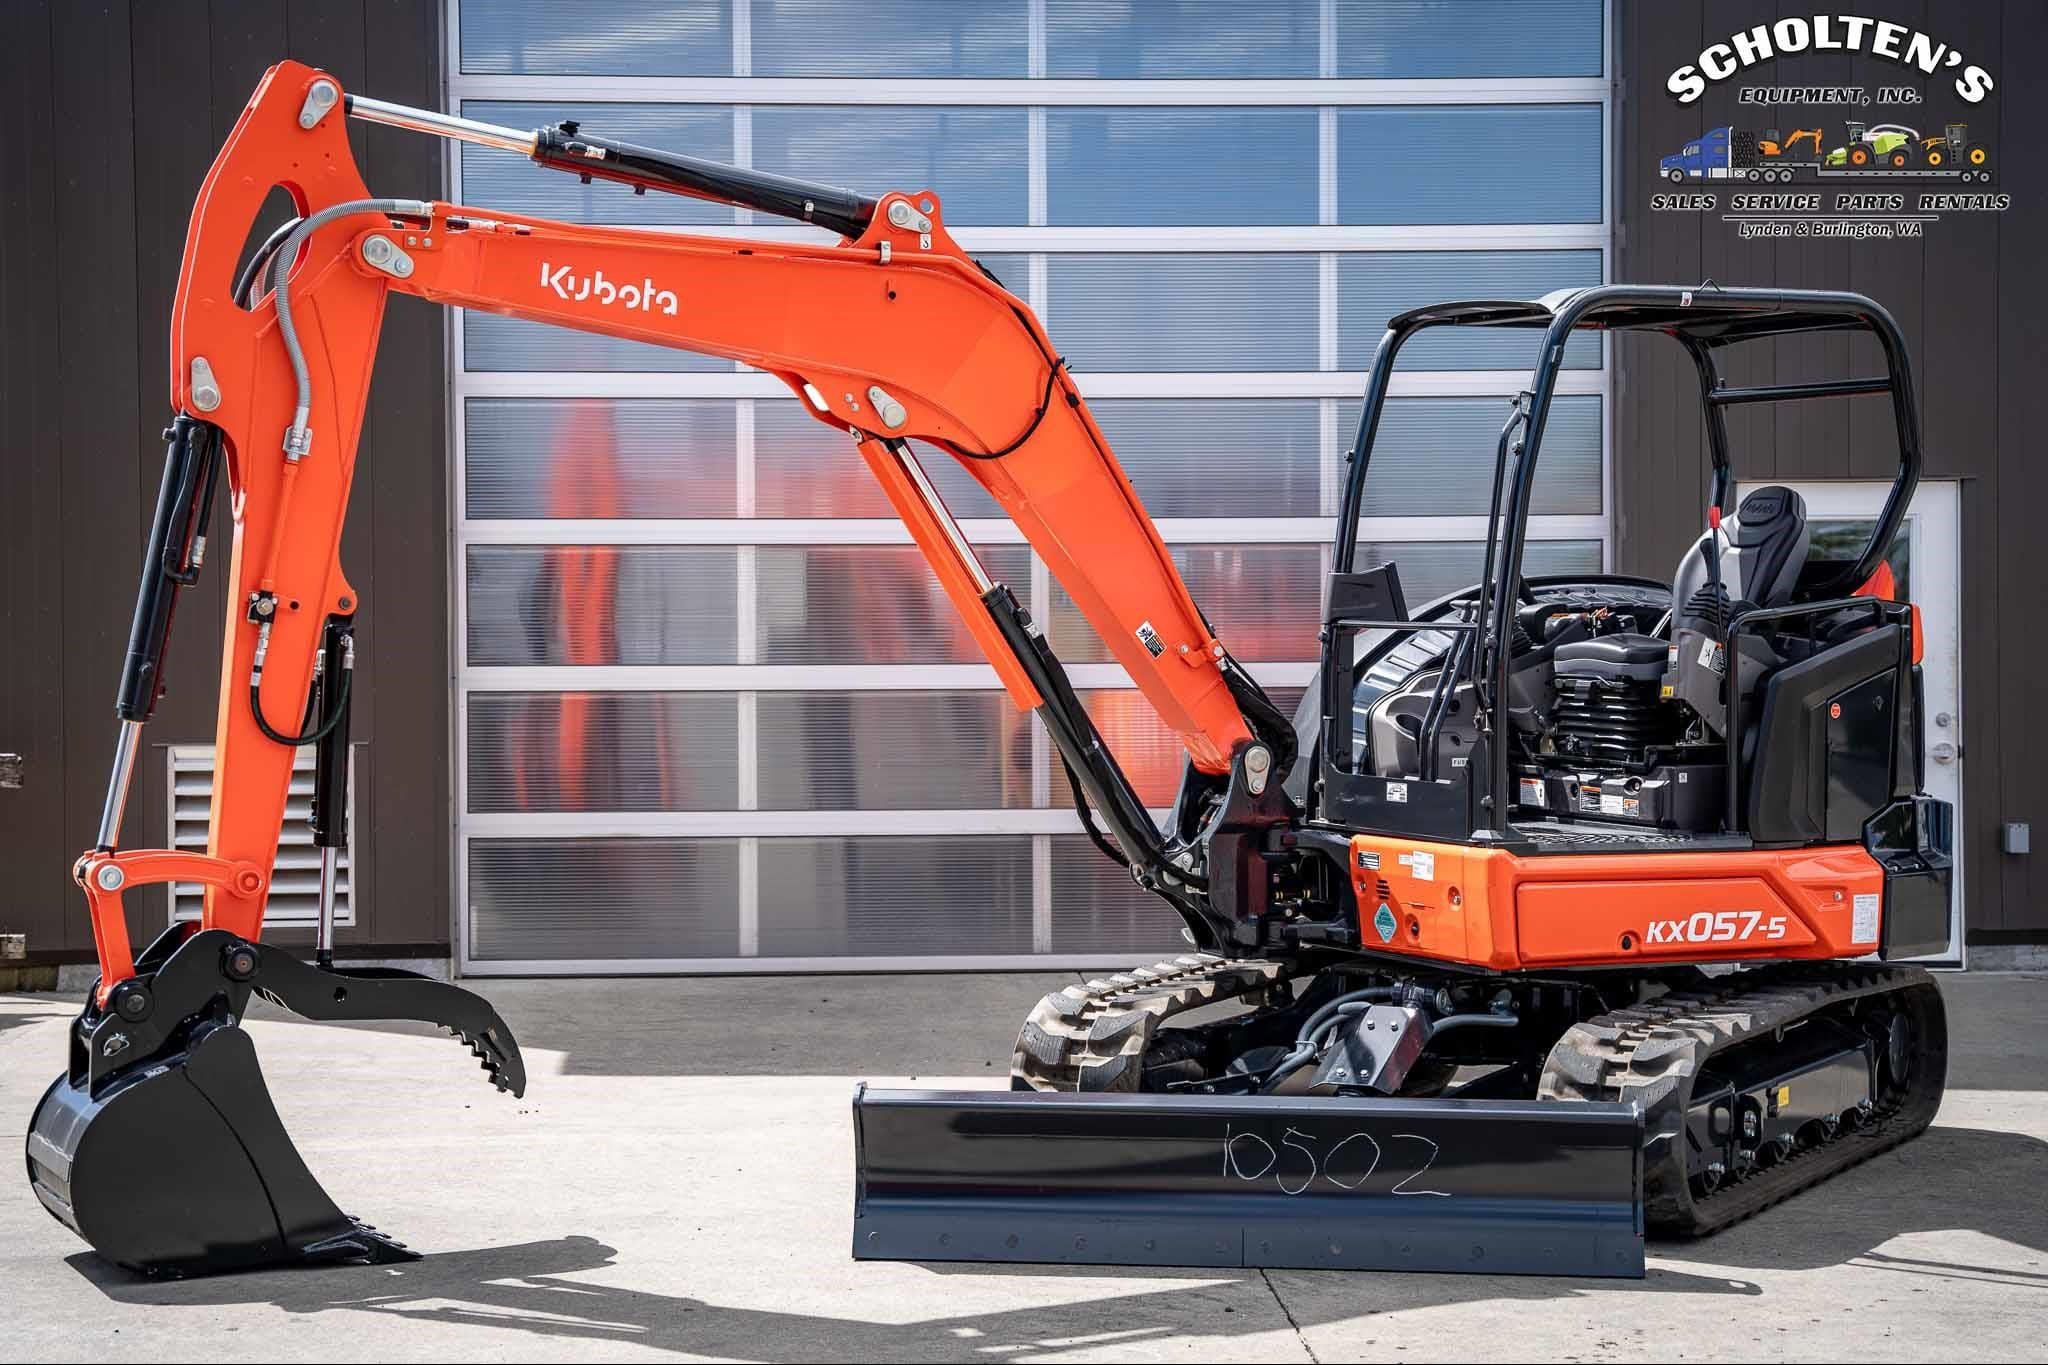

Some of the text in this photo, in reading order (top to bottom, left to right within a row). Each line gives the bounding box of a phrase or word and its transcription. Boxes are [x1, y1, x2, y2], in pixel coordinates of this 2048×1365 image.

[540, 262, 678, 315] Kubota
[1645, 911, 1787, 943] KX057-5
[1224, 1123, 1451, 1195] 10502
